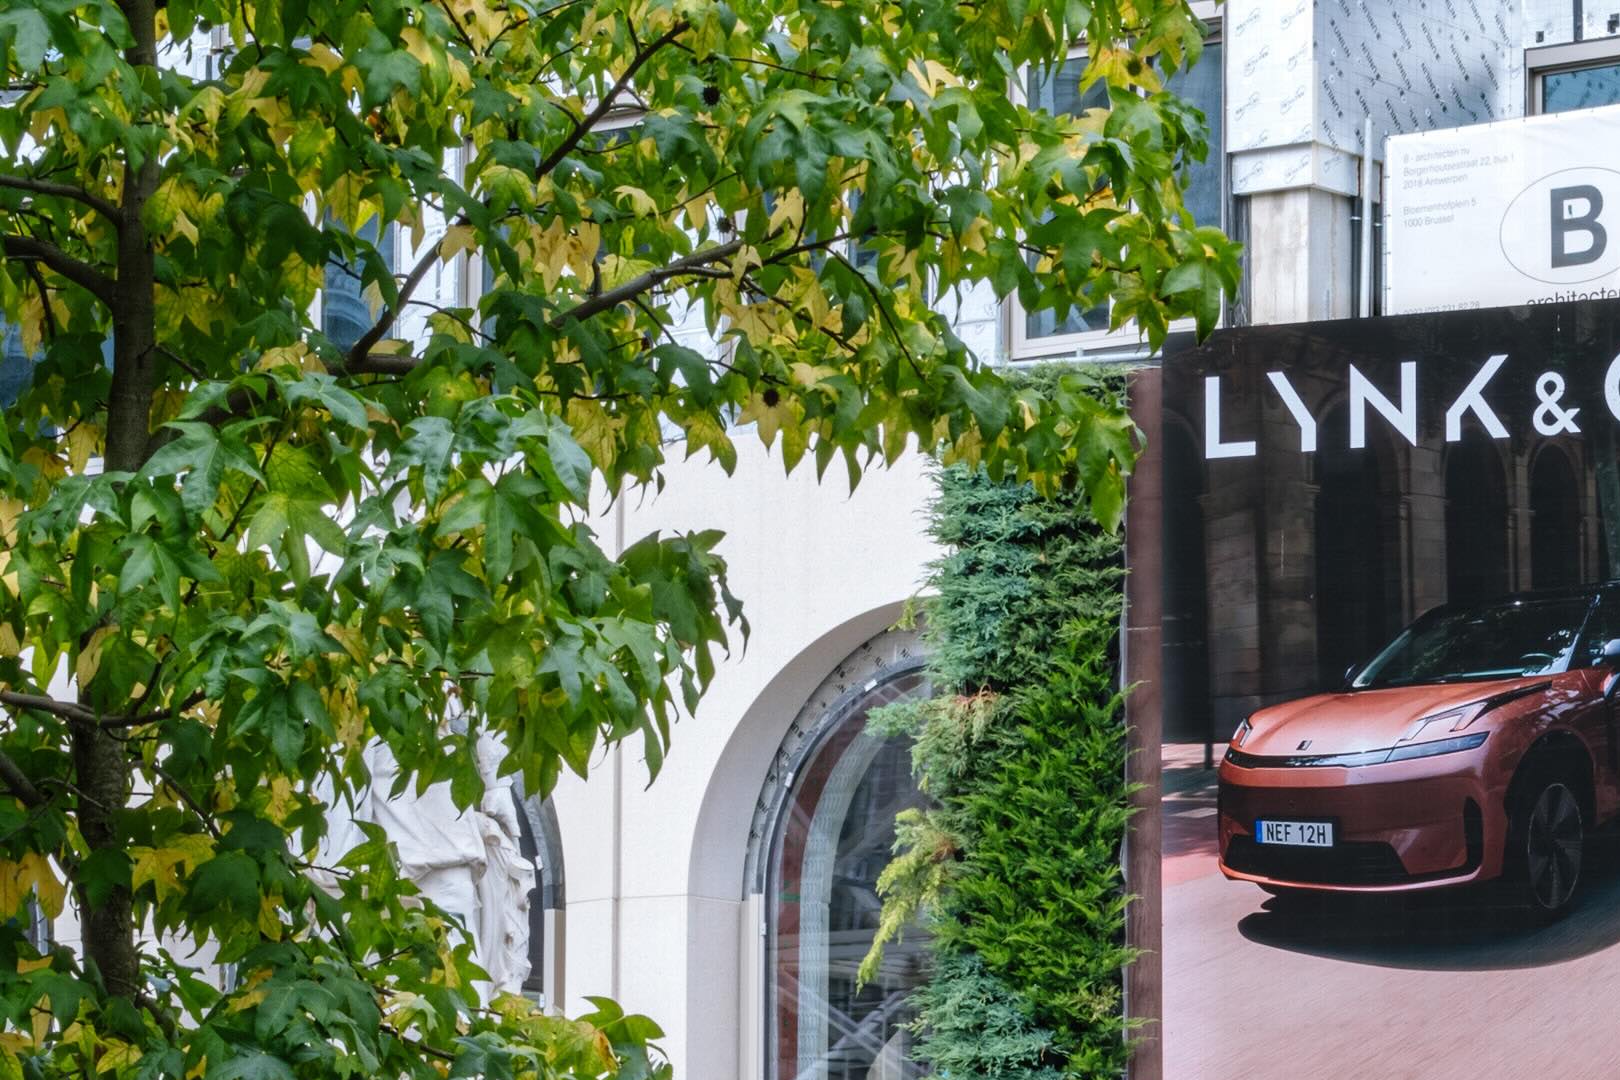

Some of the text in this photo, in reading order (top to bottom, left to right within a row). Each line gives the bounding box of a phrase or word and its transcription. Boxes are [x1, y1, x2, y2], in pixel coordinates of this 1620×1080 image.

[1550, 184, 1608, 268] B
[1266, 823, 1326, 844] NEF 12H
